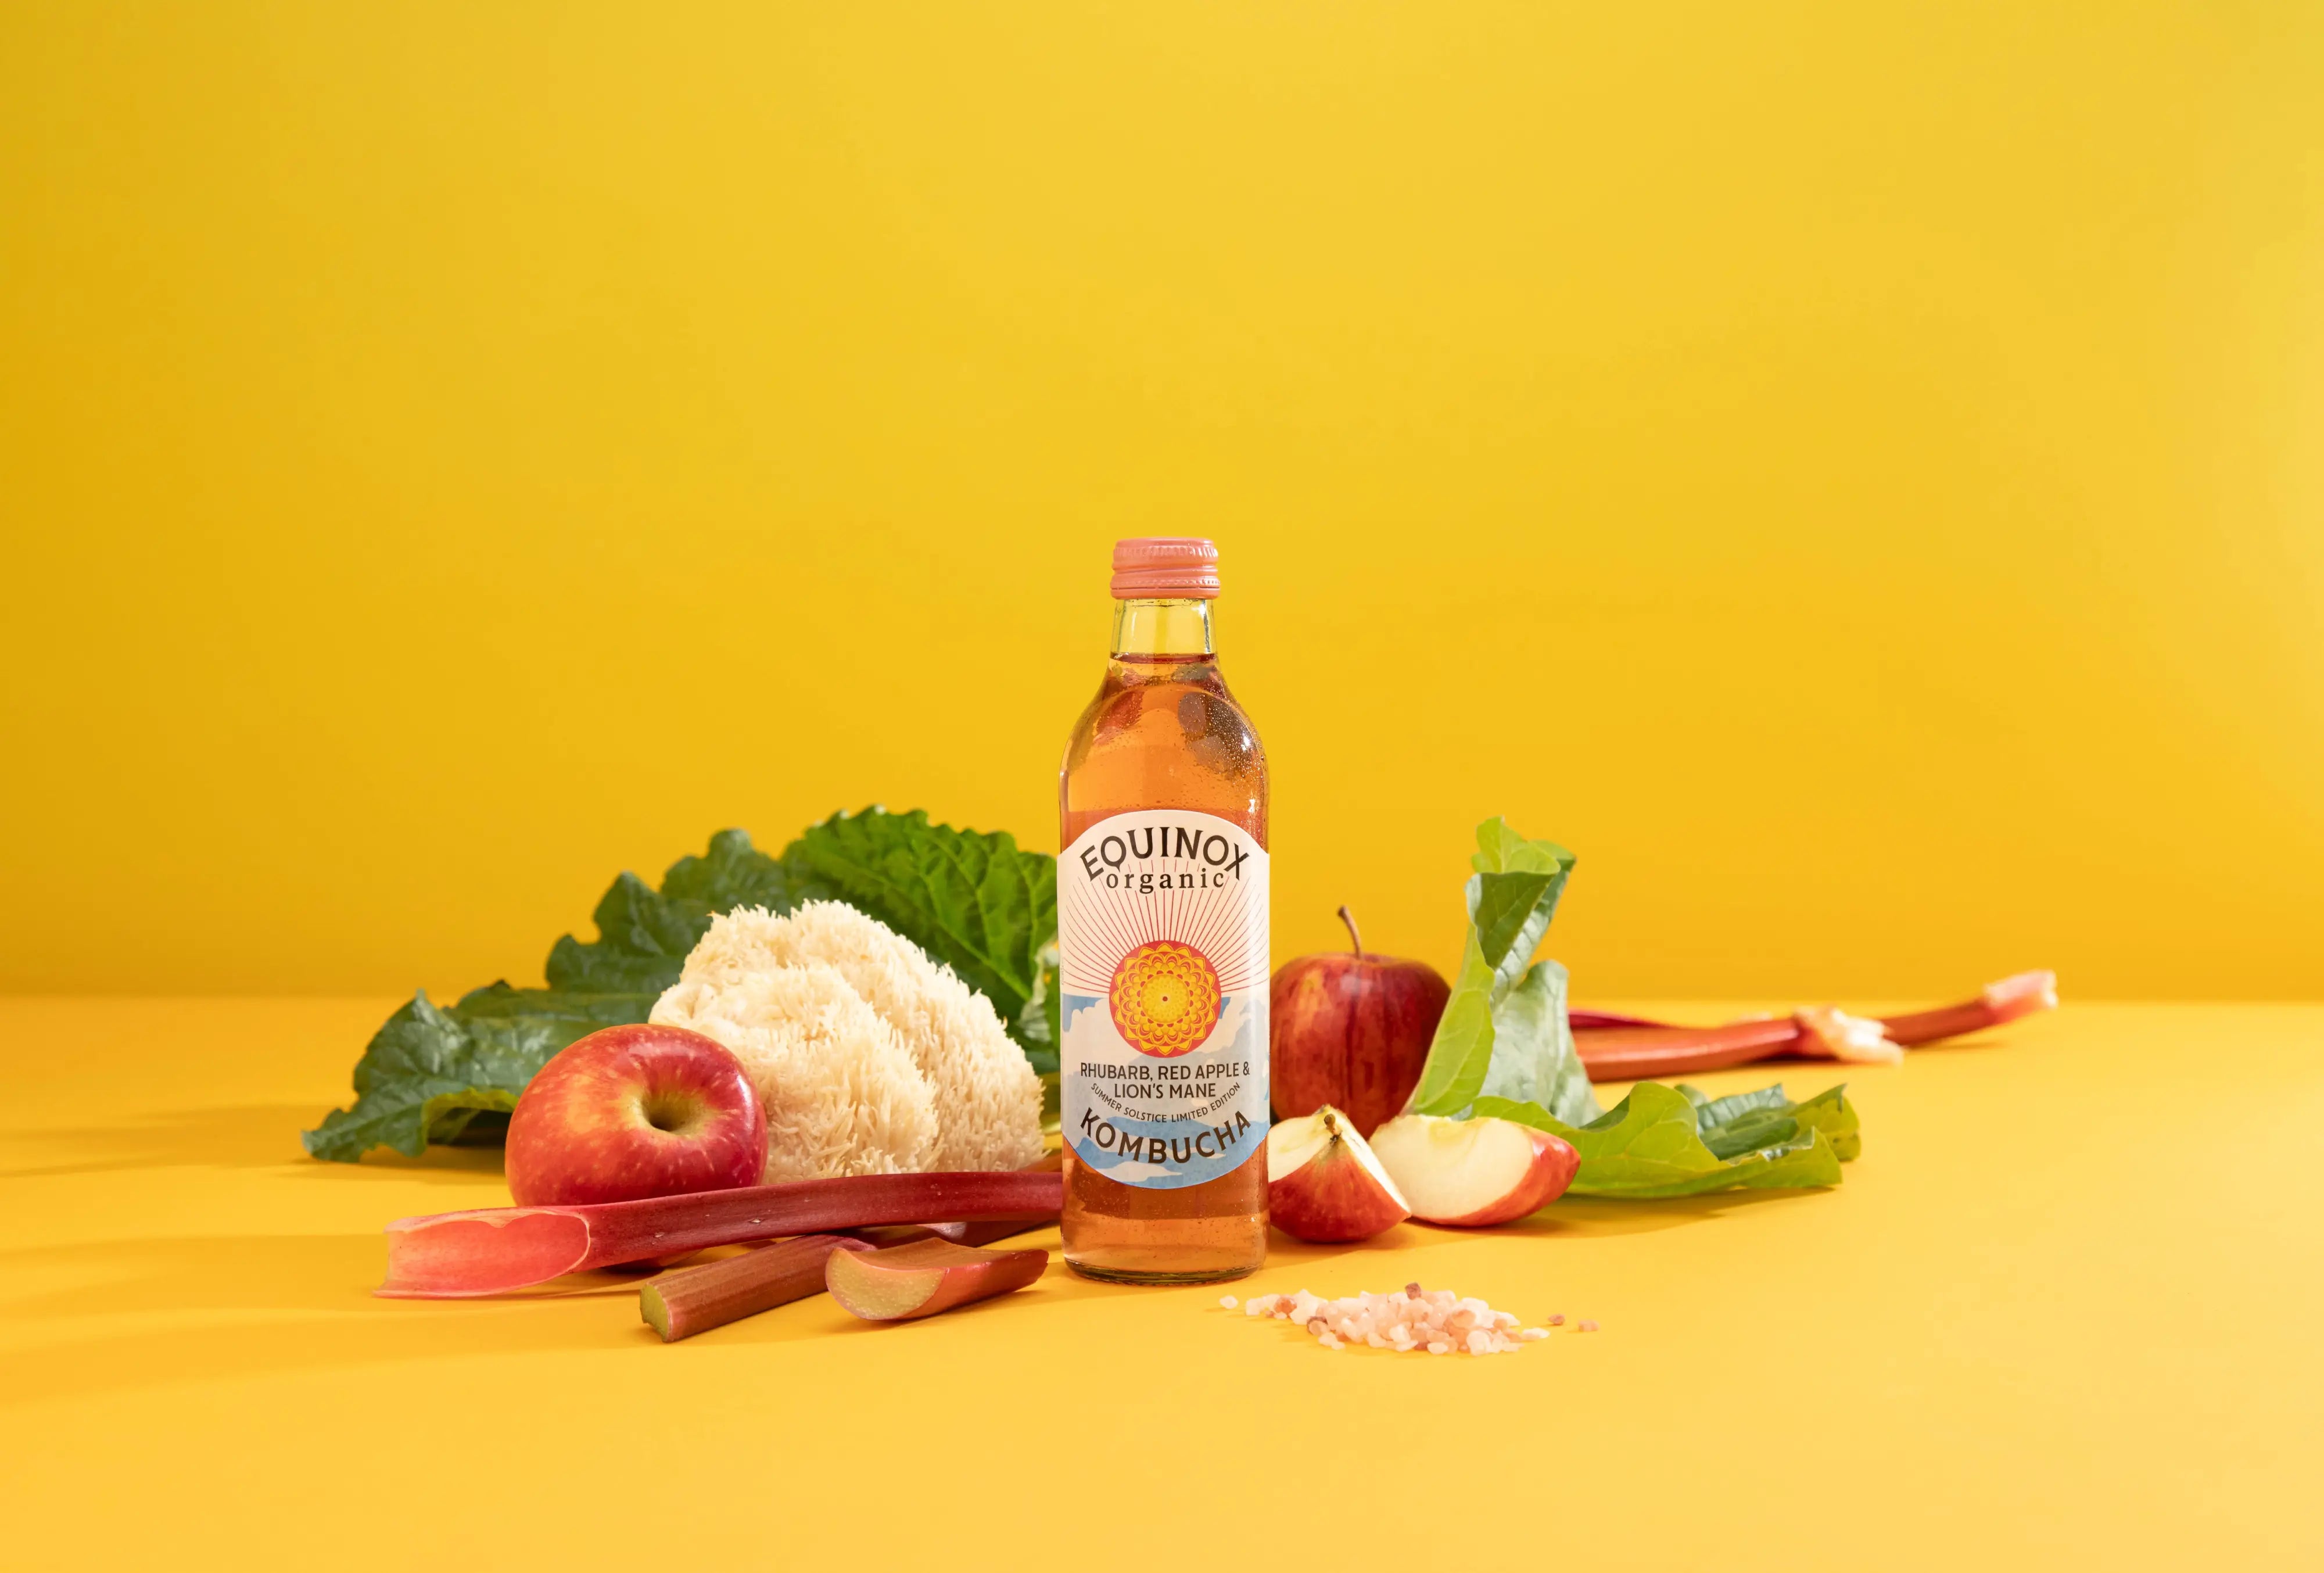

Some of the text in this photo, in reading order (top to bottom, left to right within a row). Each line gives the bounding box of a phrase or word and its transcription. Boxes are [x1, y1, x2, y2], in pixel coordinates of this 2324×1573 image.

[1080, 827, 1249, 881] EQUINOX
[1106, 868, 1224, 894] organic
[1080, 1061, 1250, 1081] RHUBARB, RED APPLE &
[1091, 1082, 1240, 1123] SUMMER SOLSTICE LIMITED EDITION
[1114, 1083, 1216, 1098] LION'S MANE
[1080, 1106, 1250, 1163] KOMBUCHA
